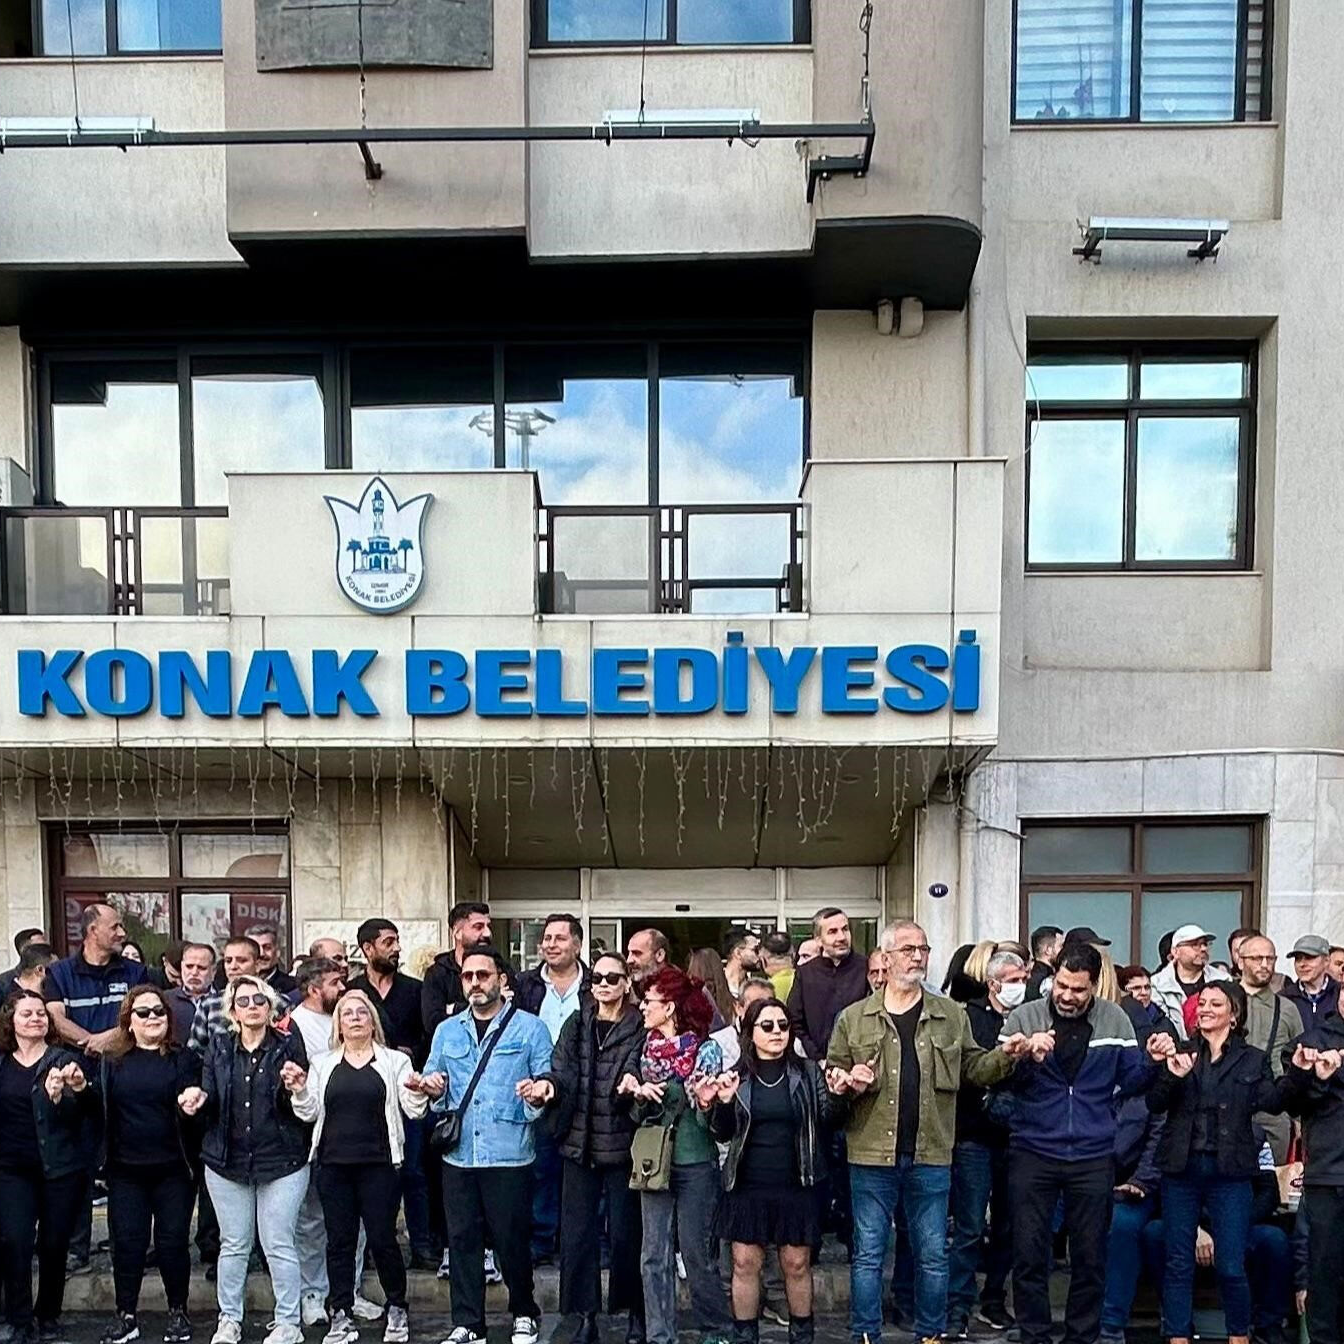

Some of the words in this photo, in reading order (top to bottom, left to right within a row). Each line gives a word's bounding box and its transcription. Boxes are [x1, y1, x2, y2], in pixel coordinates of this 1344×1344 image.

[345, 575, 371, 602] KONAK
[373, 573, 417, 603] BELEDİYESİ
[16, 648, 380, 719] KONAK
[404, 629, 981, 718] BELEDİYESİ
[236, 901, 281, 921] DİSK
